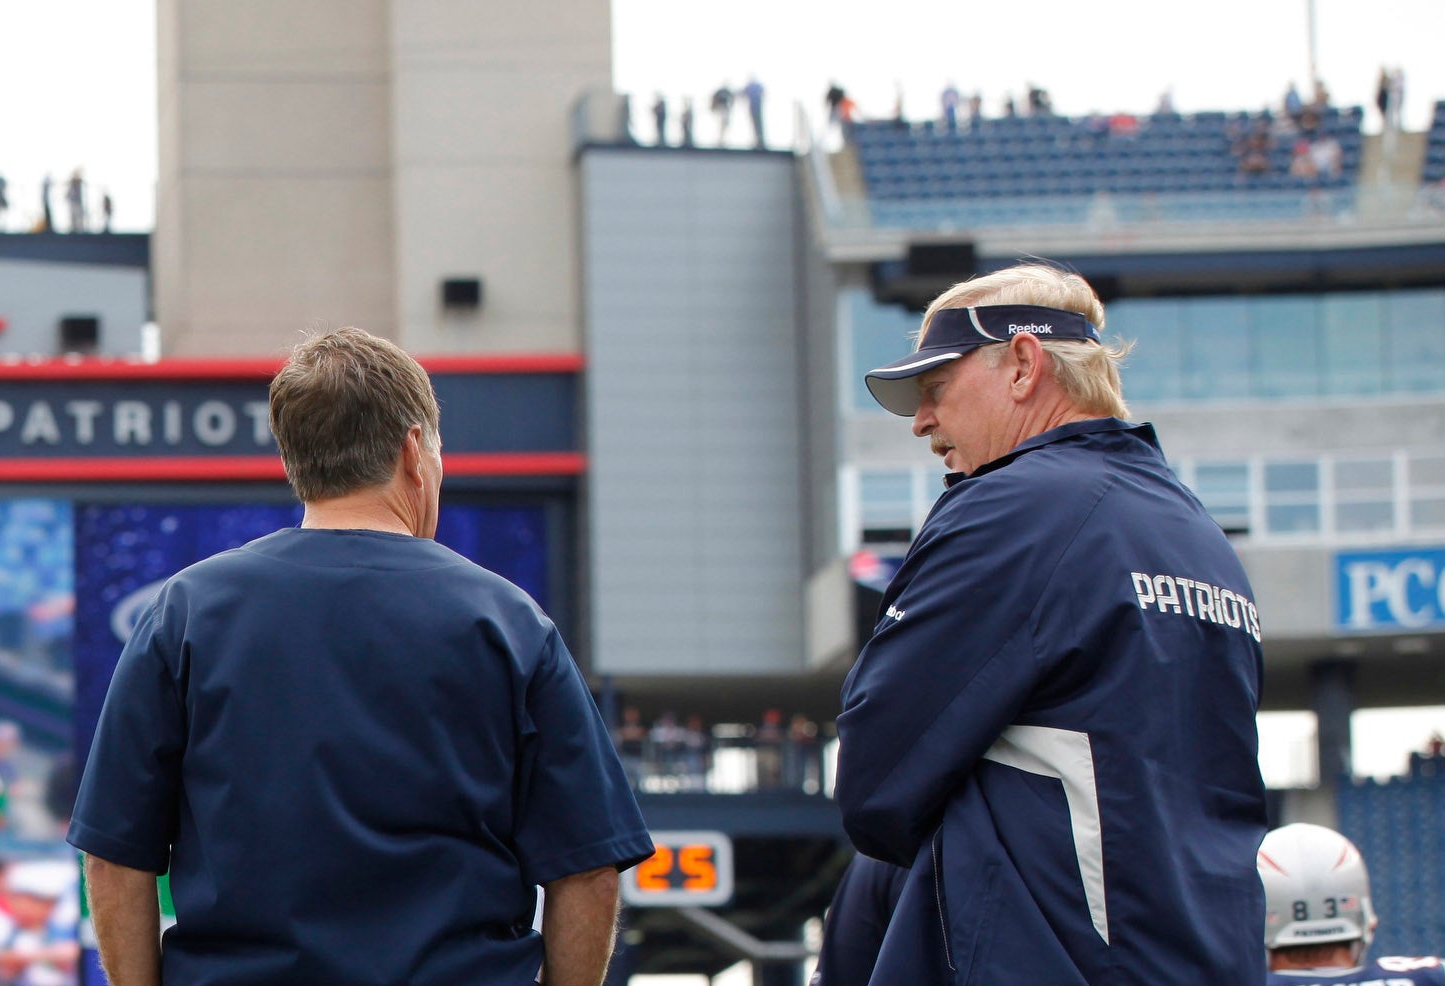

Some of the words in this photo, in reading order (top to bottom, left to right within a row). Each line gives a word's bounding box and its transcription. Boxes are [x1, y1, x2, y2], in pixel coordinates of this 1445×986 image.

[1008, 323, 1053, 335] Reebok
[1131, 572, 1261, 643] PATRIOTS
[635, 844, 717, 892] 25
